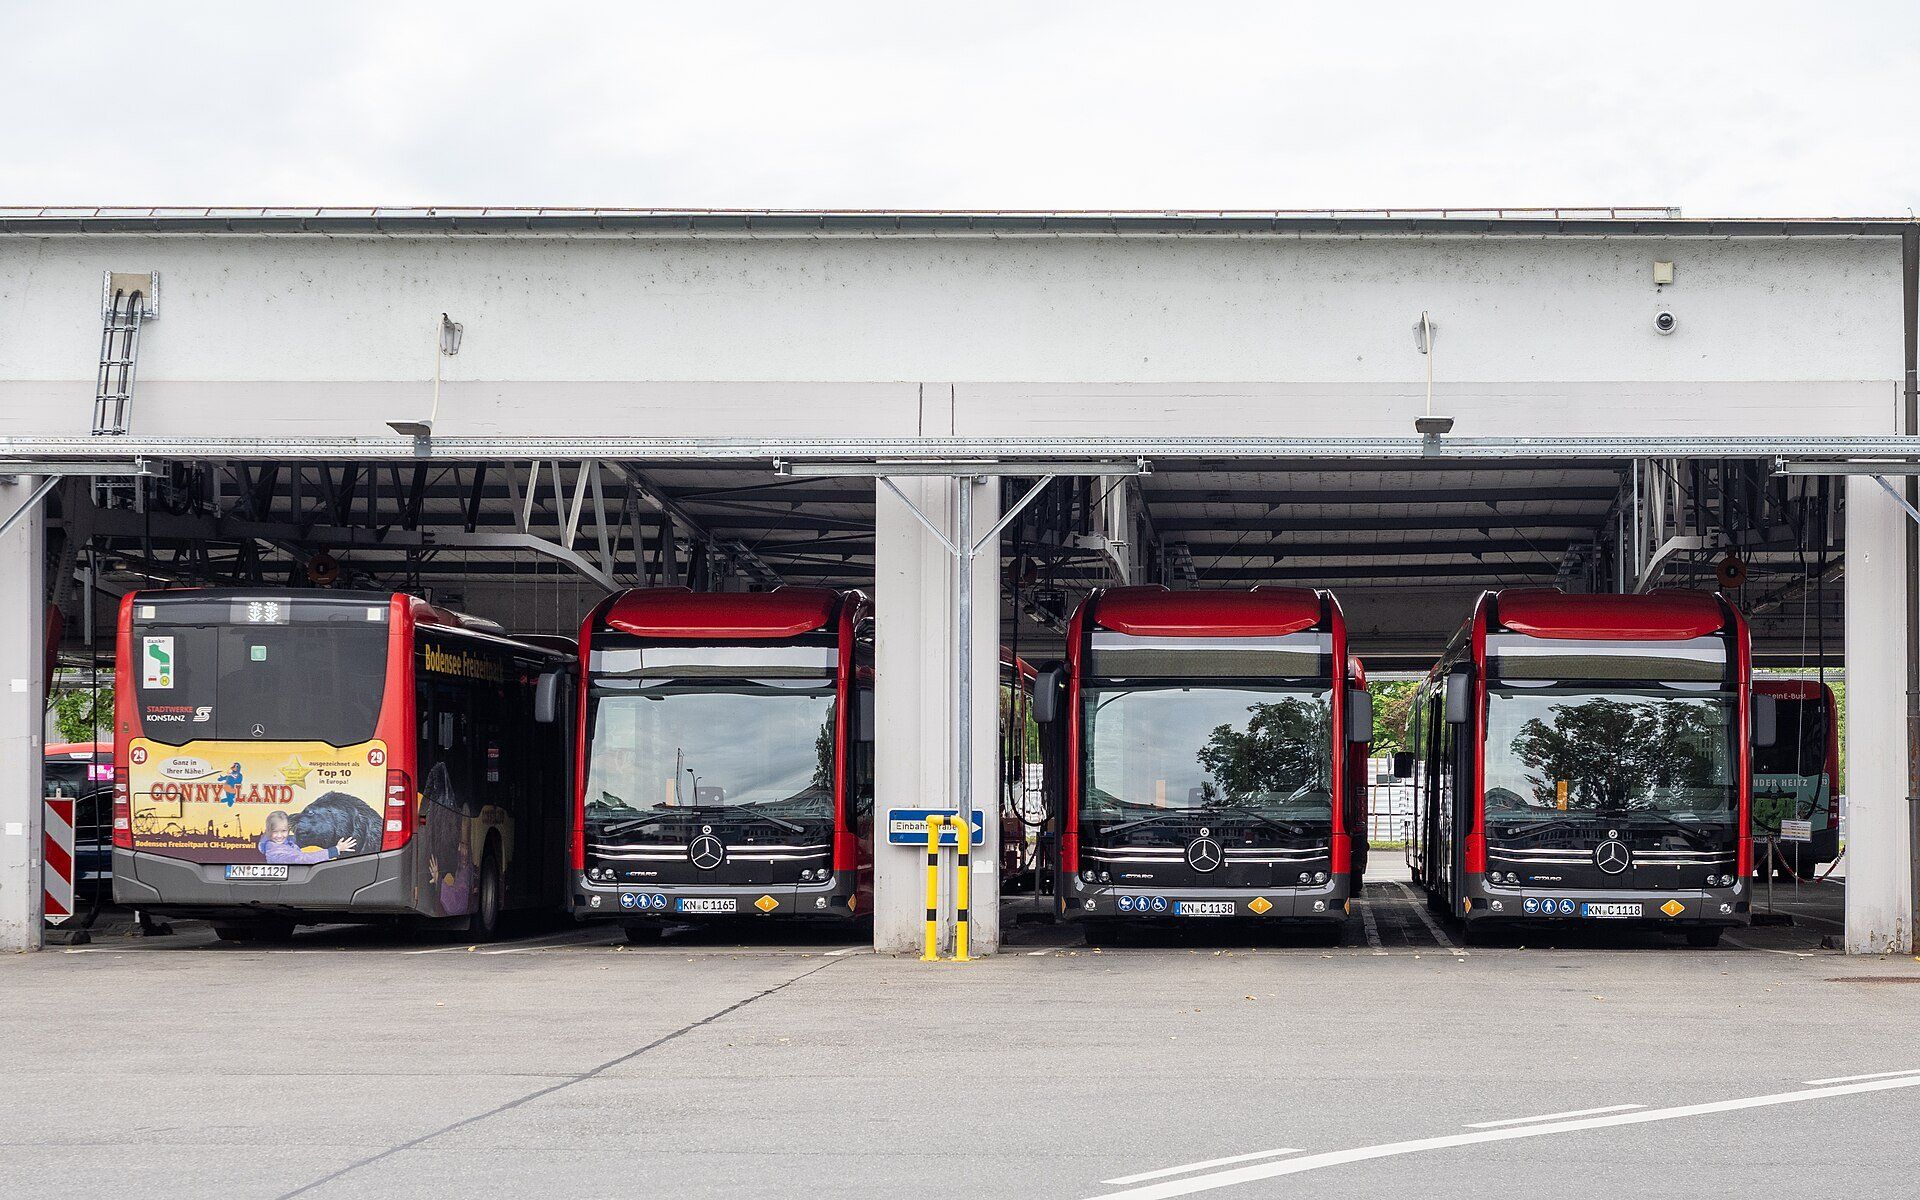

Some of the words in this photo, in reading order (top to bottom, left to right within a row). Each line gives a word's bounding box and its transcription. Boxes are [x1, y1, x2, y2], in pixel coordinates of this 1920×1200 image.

[425, 643, 461, 675] Bodensee
[133, 750, 146, 762] 29
[370, 751, 383, 763] 29
[317, 769, 338, 778] Top
[340, 769, 352, 777] 10
[151, 783, 223, 802] CONNY
[235, 783, 293, 804] LAND
[168, 841, 208, 849] Freizeitpark
[209, 842, 256, 850] CH-Lipperswil
[231, 866, 246, 876] KN
[251, 866, 259, 876] C
[260, 866, 286, 877] 1129
[683, 900, 697, 910] KN
[702, 900, 709, 910] C
[710, 900, 735, 910] 1165
[1181, 903, 1195, 914] KN
[1200, 903, 1207, 914] C
[1208, 903, 1234, 914] 1138
[1588, 905, 1602, 915] KN
[1607, 905, 1615, 915] C
[1616, 905, 1641, 915] 1118
